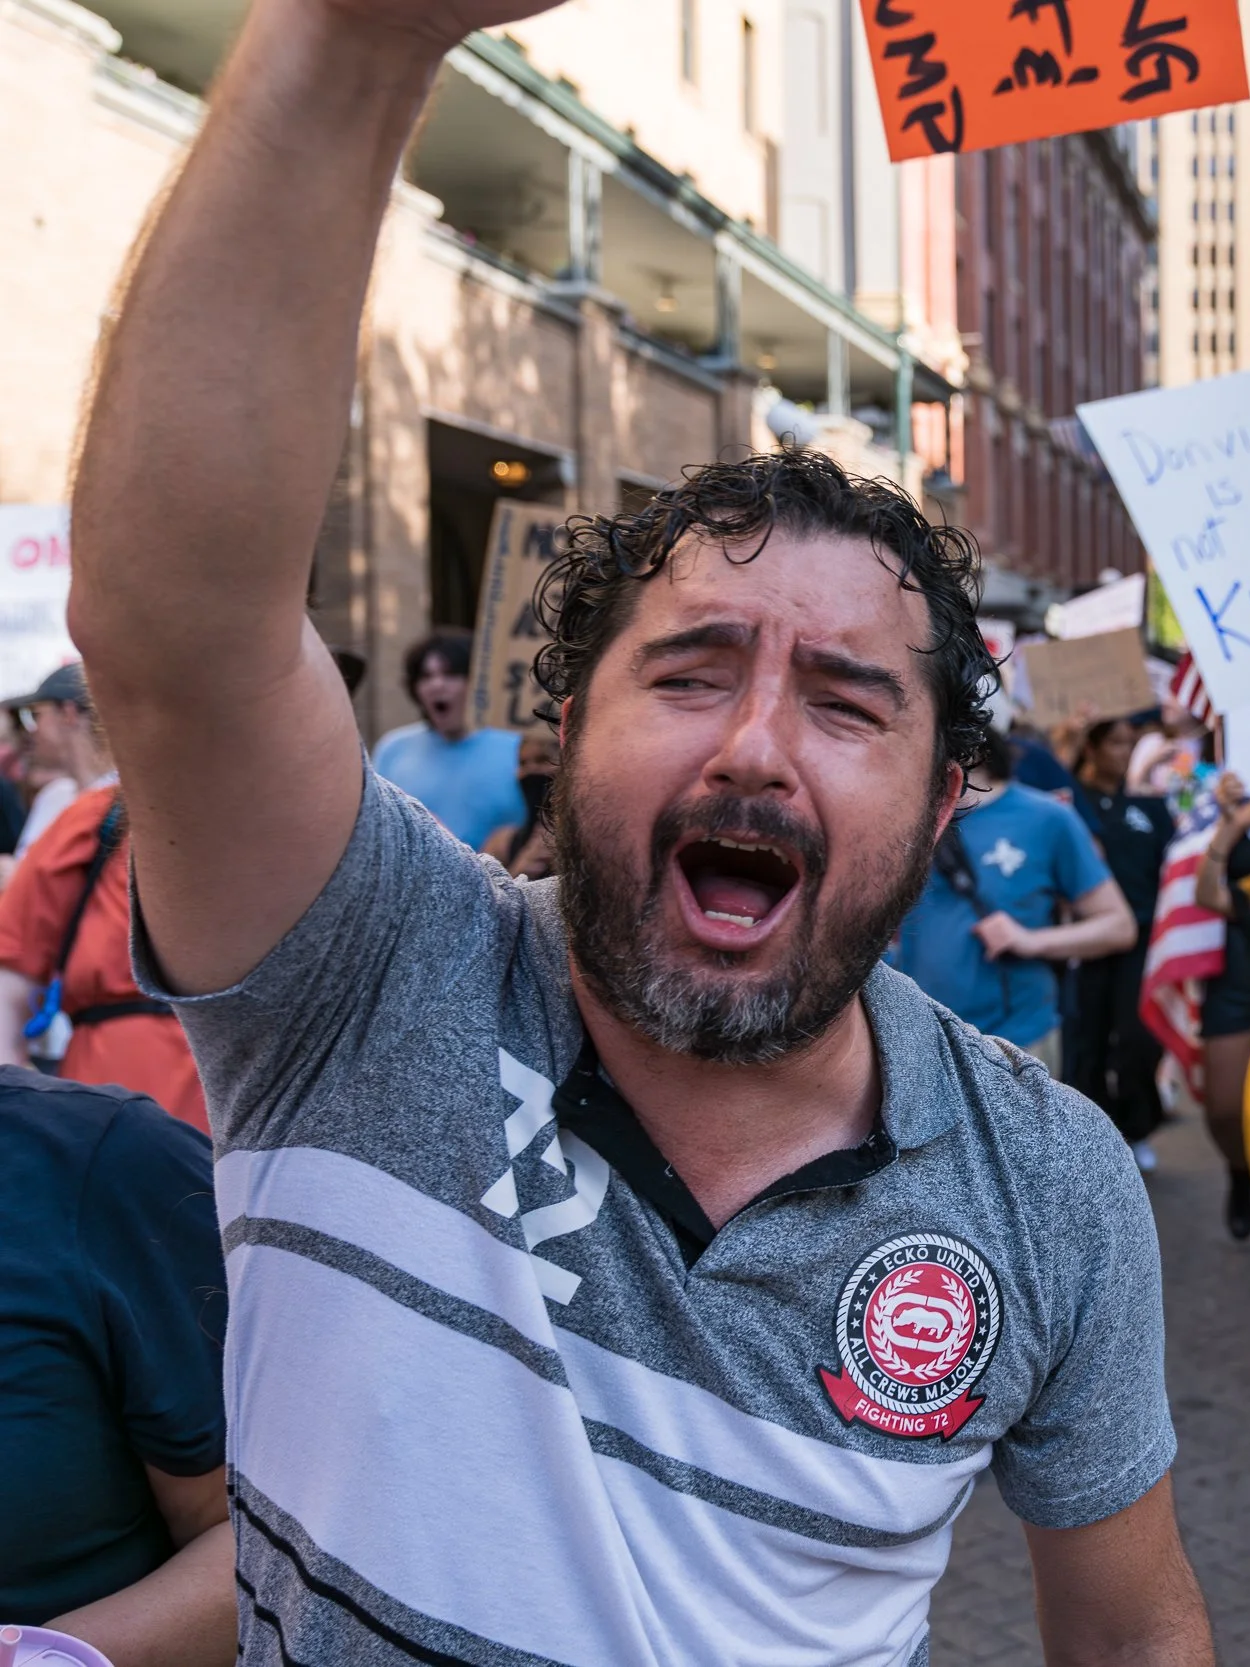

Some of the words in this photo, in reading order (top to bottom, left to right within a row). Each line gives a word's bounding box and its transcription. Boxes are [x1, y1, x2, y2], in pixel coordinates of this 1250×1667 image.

[937, 1247, 980, 1293] UNLTD.
[850, 1337, 867, 1369] ALL
[870, 1371, 919, 1402] CREWS
[925, 1357, 975, 1401] MAJOR
[855, 1398, 925, 1433] FIGHTING
